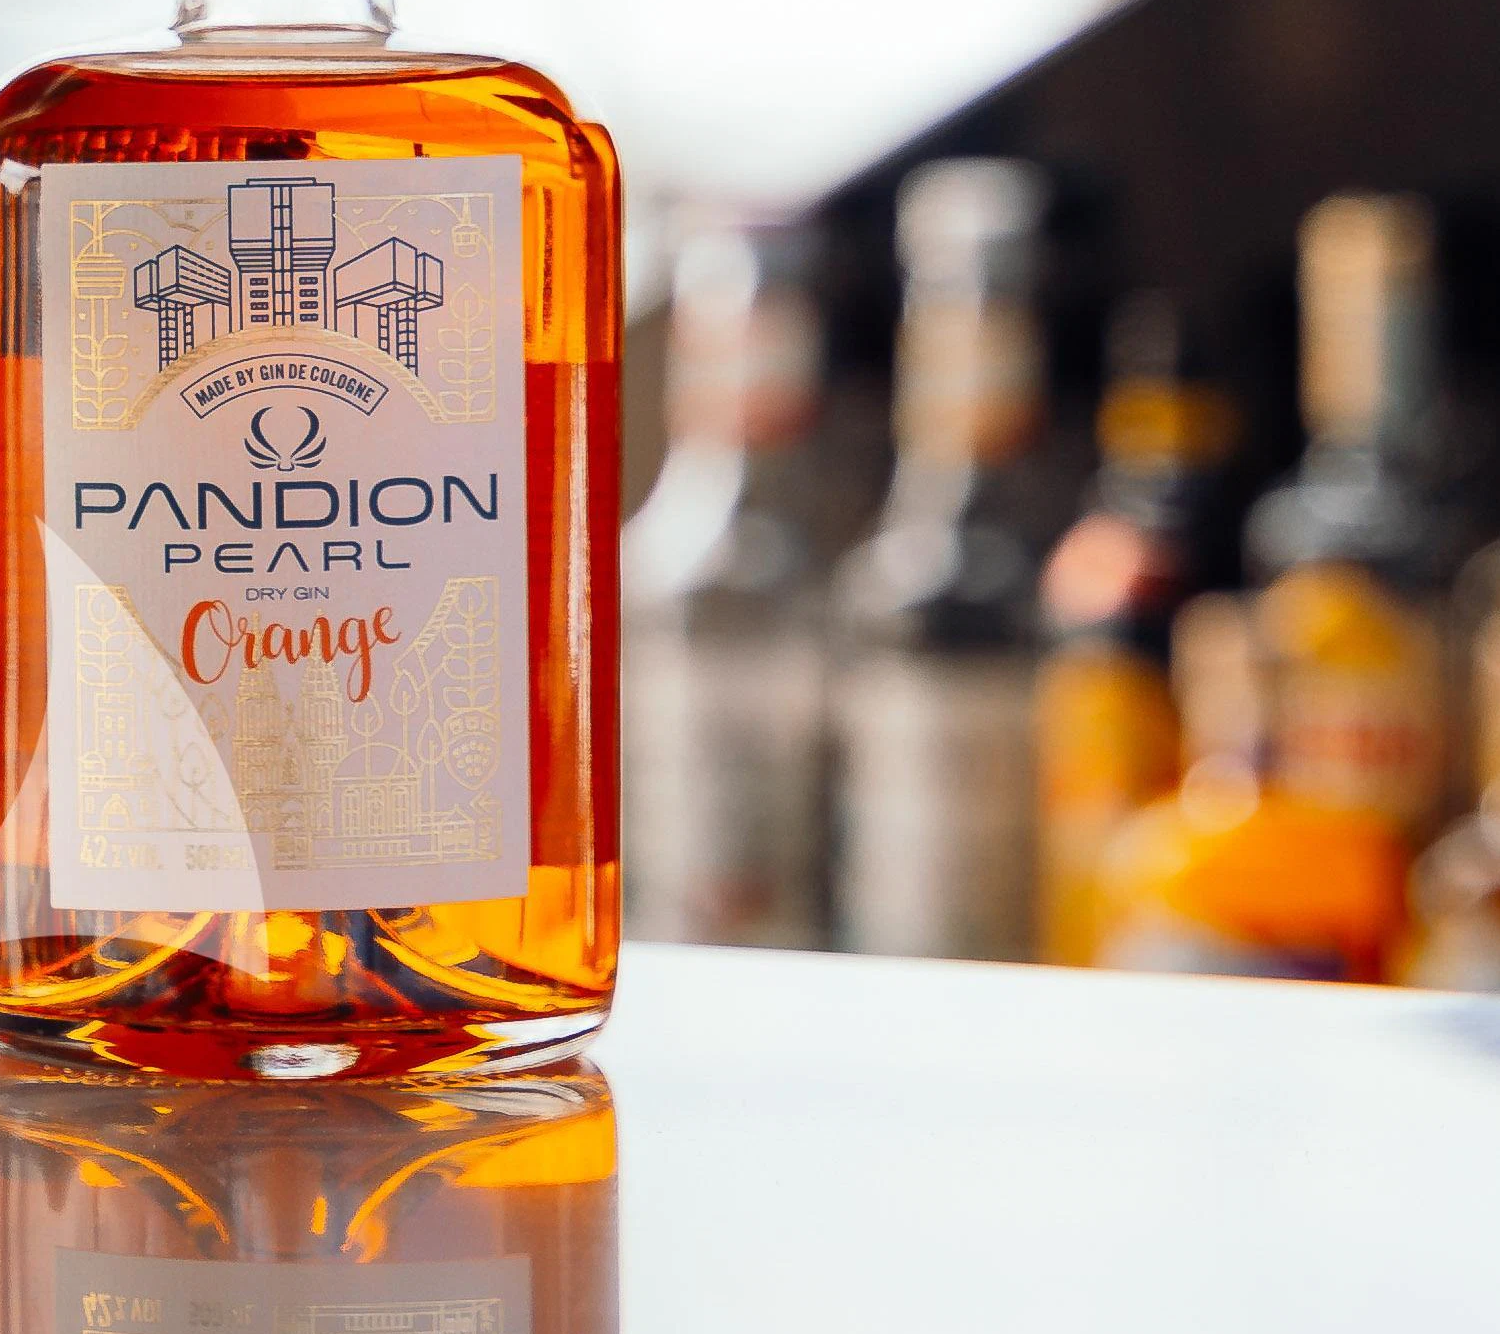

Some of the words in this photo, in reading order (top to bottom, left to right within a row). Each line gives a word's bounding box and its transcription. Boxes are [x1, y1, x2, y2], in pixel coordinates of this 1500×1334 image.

[194, 375, 235, 406] MADE
[236, 368, 255, 386] BY
[260, 363, 285, 381] GIN
[288, 363, 307, 380] DE
[310, 365, 375, 403] COLOGNE
[74, 473, 498, 530] PANDION
[163, 539, 411, 573] PEARL
[245, 587, 288, 602] DRY
[293, 585, 330, 600] GIN
[181, 599, 402, 703] Orange
